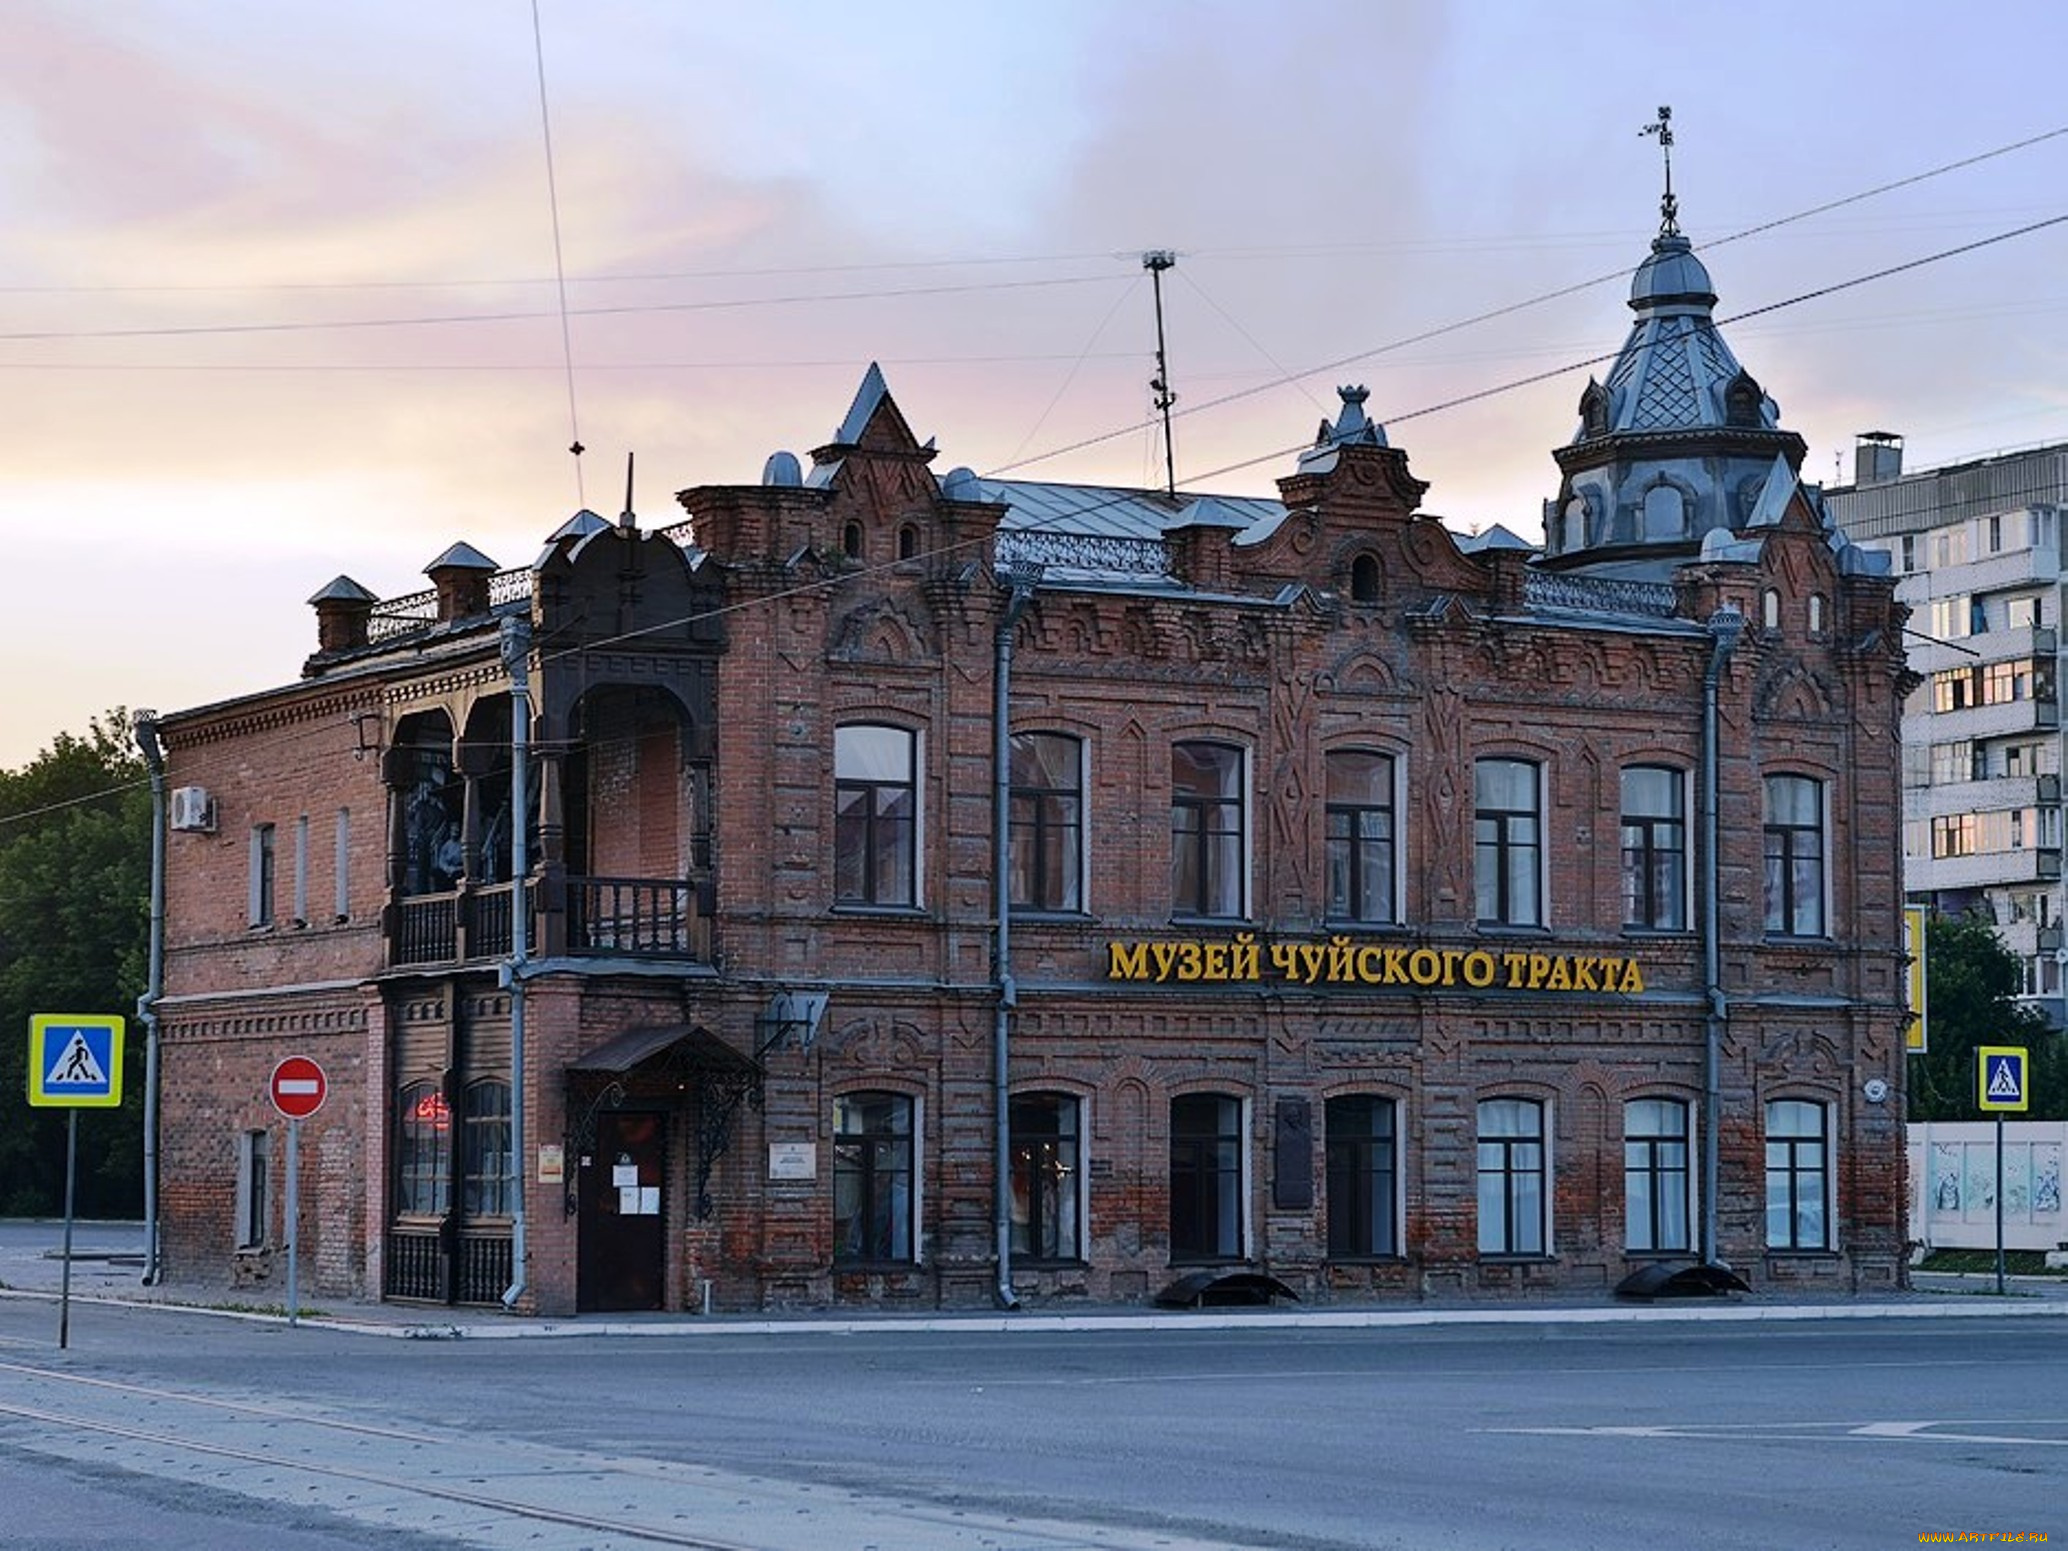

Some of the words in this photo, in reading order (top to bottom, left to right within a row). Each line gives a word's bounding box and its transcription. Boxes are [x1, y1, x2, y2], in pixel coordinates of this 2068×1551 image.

[1109, 933, 1261, 981] МУЗЕЙ
[1272, 936, 1495, 987] ЧУЙСКОГО
[1504, 952, 1644, 993] ТРАКТА
